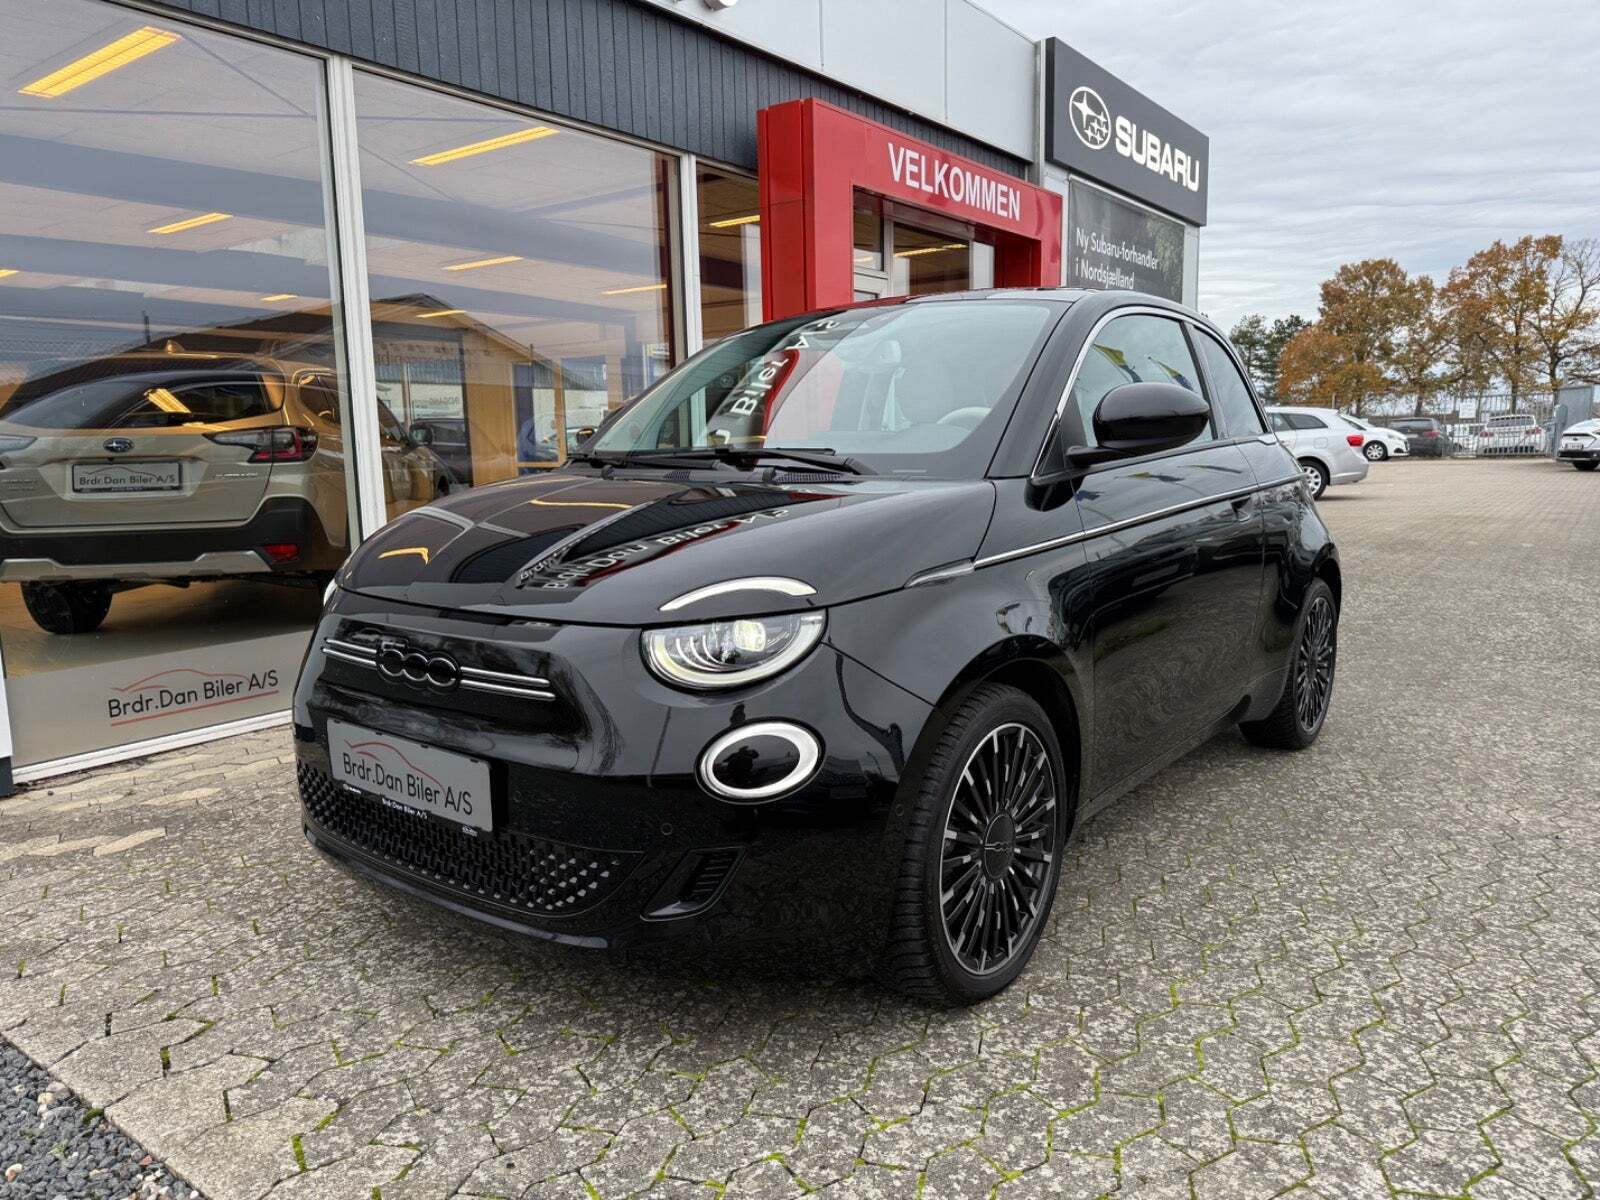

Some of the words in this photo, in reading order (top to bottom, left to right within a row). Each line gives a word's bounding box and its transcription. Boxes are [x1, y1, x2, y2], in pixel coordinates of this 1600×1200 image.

[1115, 115, 1199, 192] SUBARU
[888, 142, 1020, 221] VELKOMMEN
[1076, 227, 1090, 254] Ny
[1091, 232, 1158, 270] Subaru-forhandler
[1075, 257, 1079, 277] i
[1080, 260, 1135, 290] Nordsjælland
[129, 474, 153, 485] Biler
[108, 689, 198, 718] Brdr.Dan
[203, 679, 243, 701] Biler
[248, 669, 279, 691] A/S
[342, 752, 403, 793] Brdr.Dan
[406, 773, 441, 804] Biler
[444, 786, 473, 816] A/S
